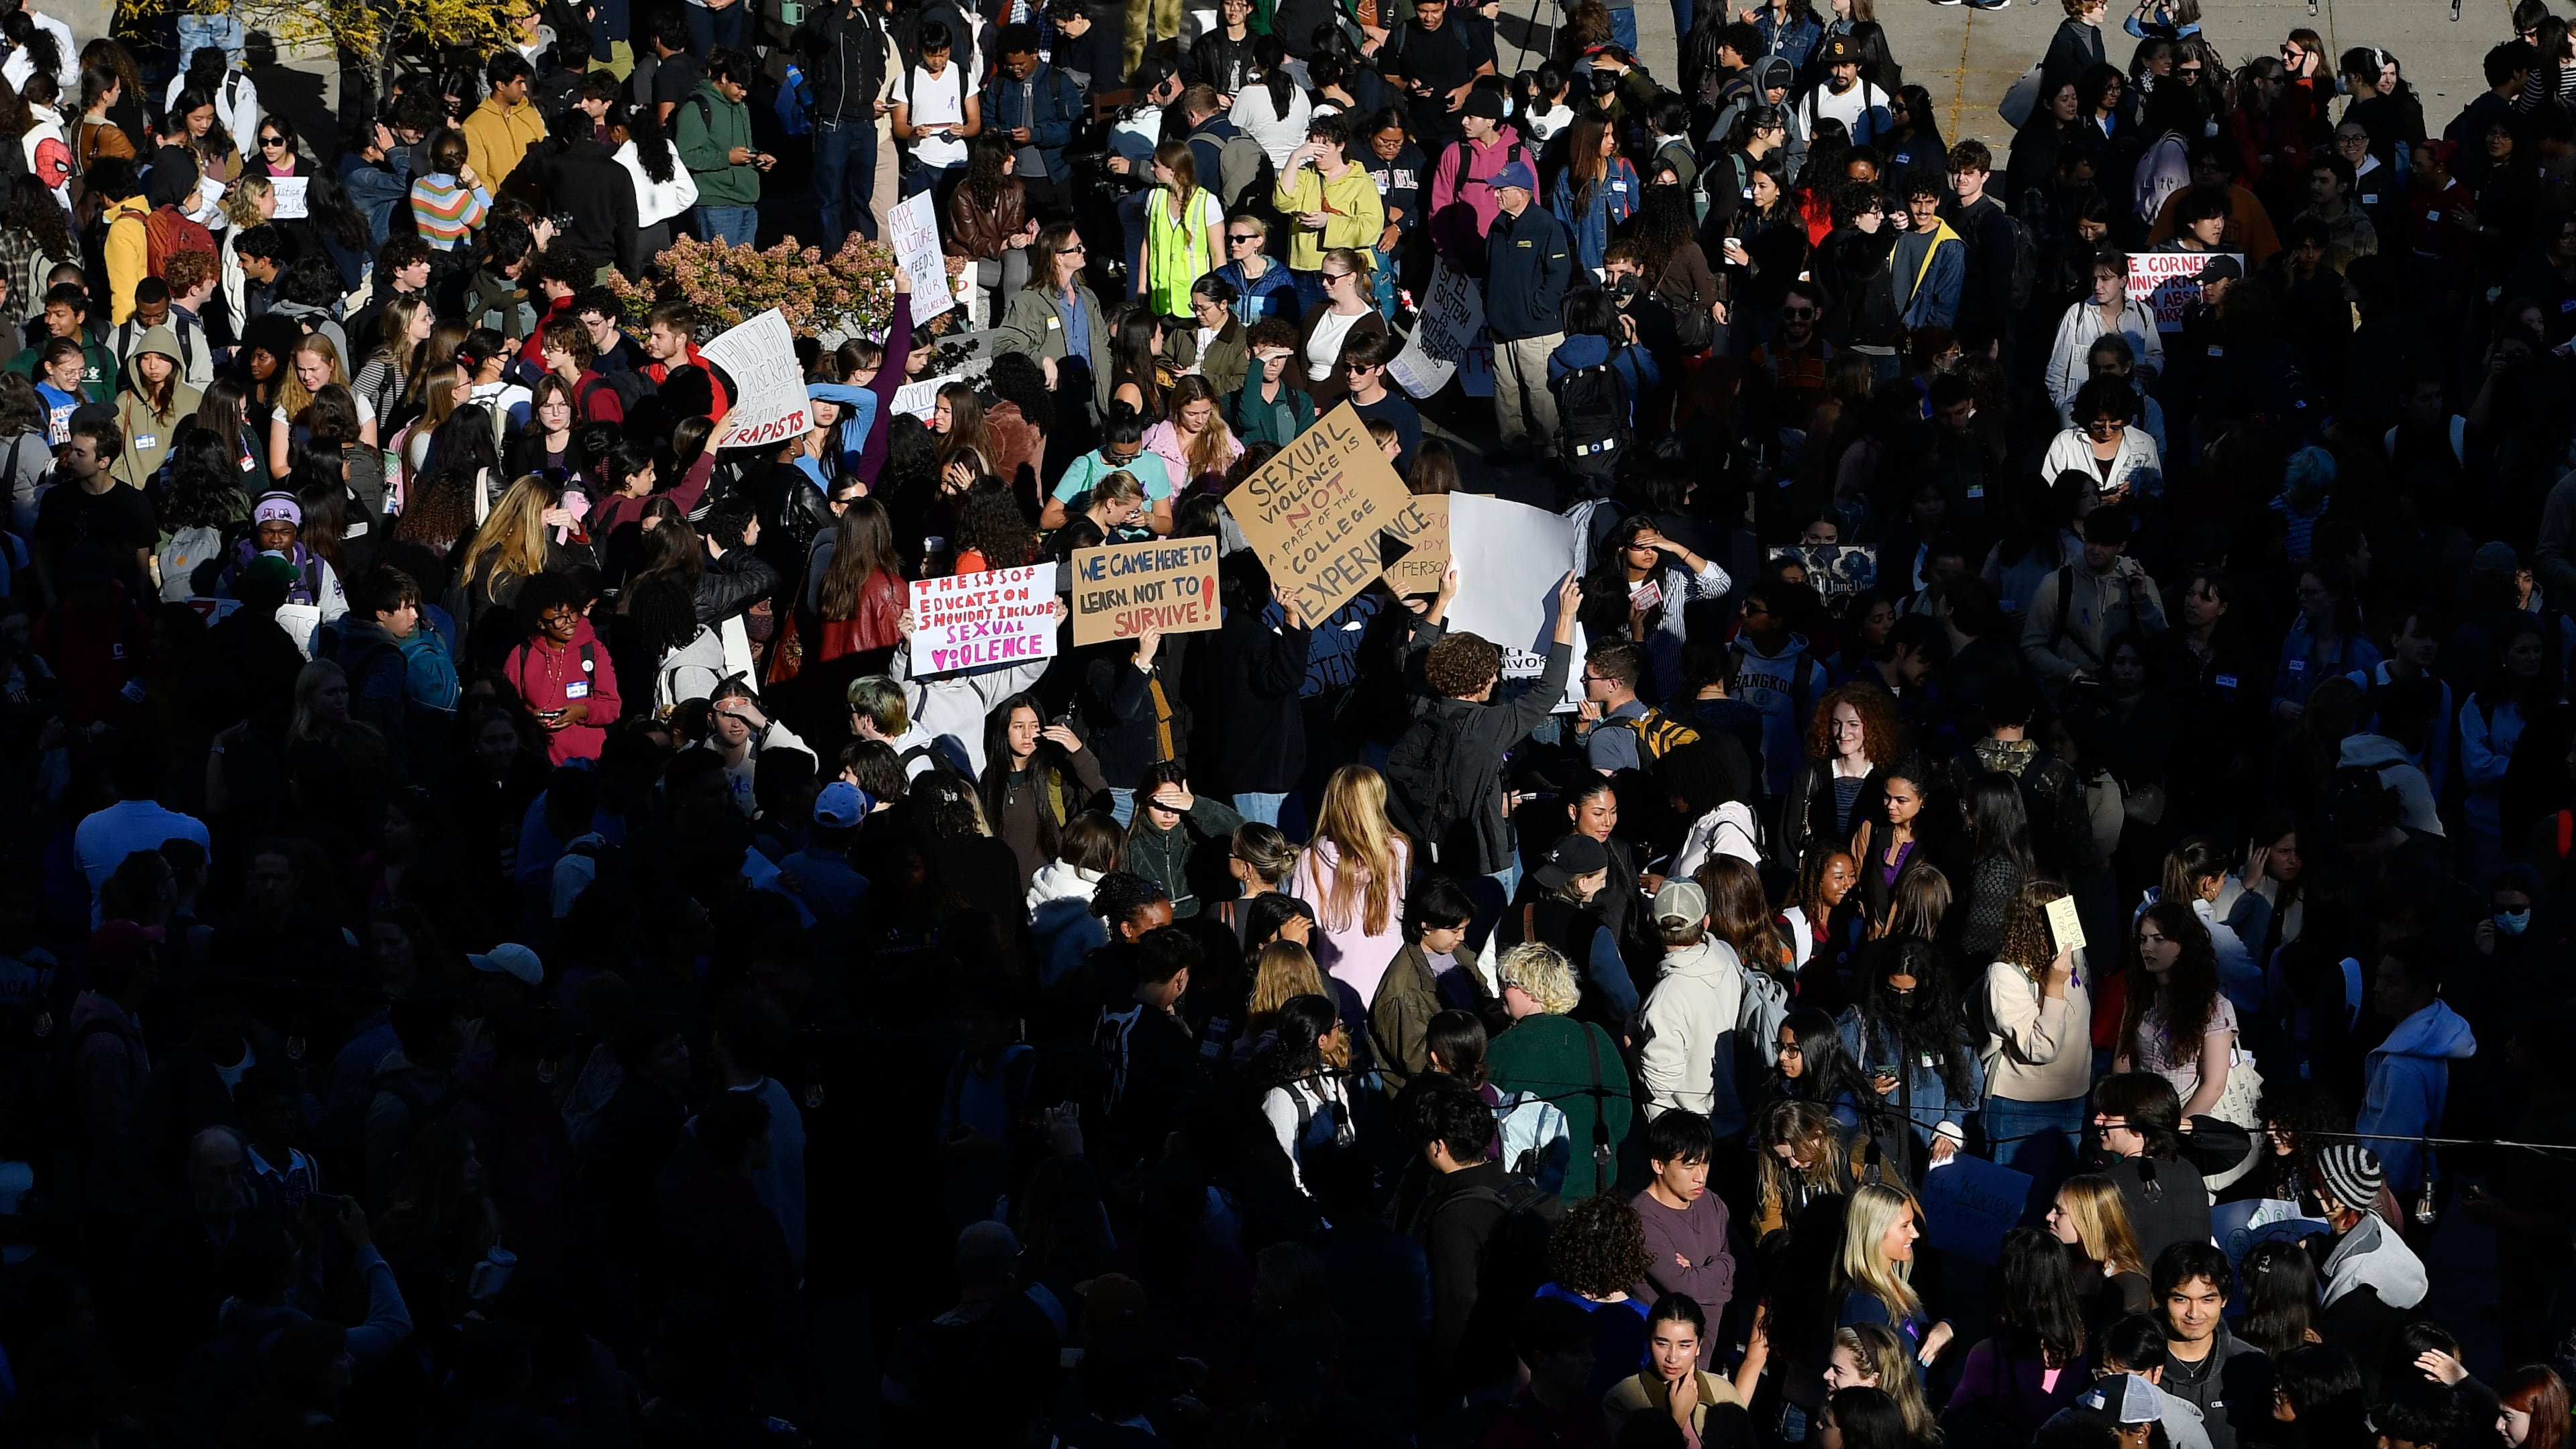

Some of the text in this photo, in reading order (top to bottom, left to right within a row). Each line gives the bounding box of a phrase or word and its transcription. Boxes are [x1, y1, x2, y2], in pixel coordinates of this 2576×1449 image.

[890, 201, 919, 236] RAPE
[894, 225, 934, 258] CULTURE
[911, 250, 934, 276] FEEDS
[917, 271, 927, 284] ON
[912, 279, 941, 304] YOUR
[912, 294, 952, 323] COMPLACENCY
[1434, 283, 1471, 329] SISTEMA
[704, 317, 786, 370] THINGS THAT
[738, 354, 792, 399] CAUSE RAPE
[733, 411, 804, 445] RAPISTS
[1248, 422, 1352, 508] SEXUAL
[1259, 436, 1360, 525] VIOLENCE IS
[1286, 471, 1344, 530] NOT
[1269, 488, 1358, 566] A PART OF THE
[915, 574, 967, 595] THE
[1010, 568, 1035, 582] OF
[1078, 545, 1212, 584] WE CAME HERE TO
[920, 588, 1028, 613] EDUCATION
[1080, 576, 1199, 614] LEARN, NOT TO
[1828, 580, 1852, 594] Jane
[947, 621, 1024, 644] SEXUAL
[1299, 653, 1358, 697] STEN
[2061, 900, 2074, 917] NO
